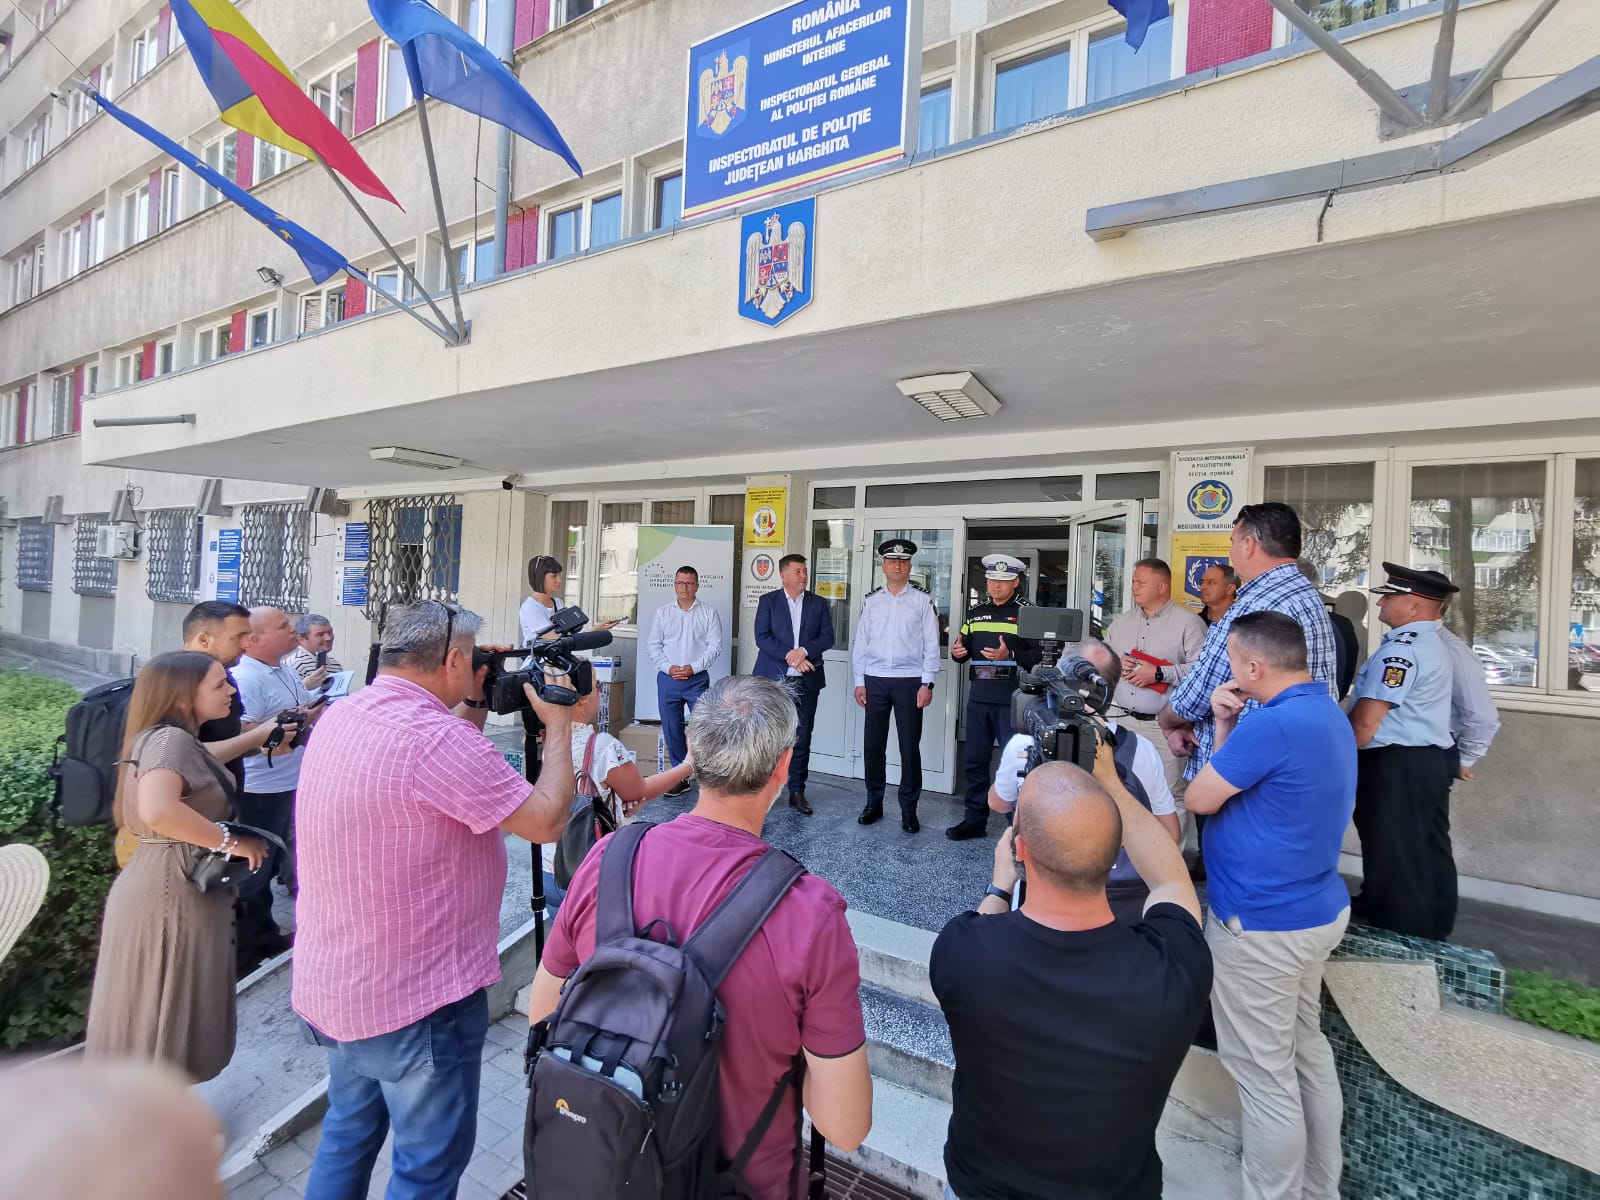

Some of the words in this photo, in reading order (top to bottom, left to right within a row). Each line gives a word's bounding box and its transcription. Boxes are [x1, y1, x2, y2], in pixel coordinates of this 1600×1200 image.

[764, 36, 822, 66] MINISTERUL
[825, 6, 891, 41] AFACERILOR
[792, 0, 861, 35] ROMÂNIA
[802, 39, 846, 67] INTERNE
[760, 73, 838, 111] INSPECTORATUL
[840, 55, 891, 82] GENERAL
[771, 108, 784, 122] AL
[829, 75, 876, 102] ROMÂNE
[709, 133, 798, 173] INSPECTORATUL
[802, 127, 819, 143] DE
[787, 135, 850, 167] HARGHITA
